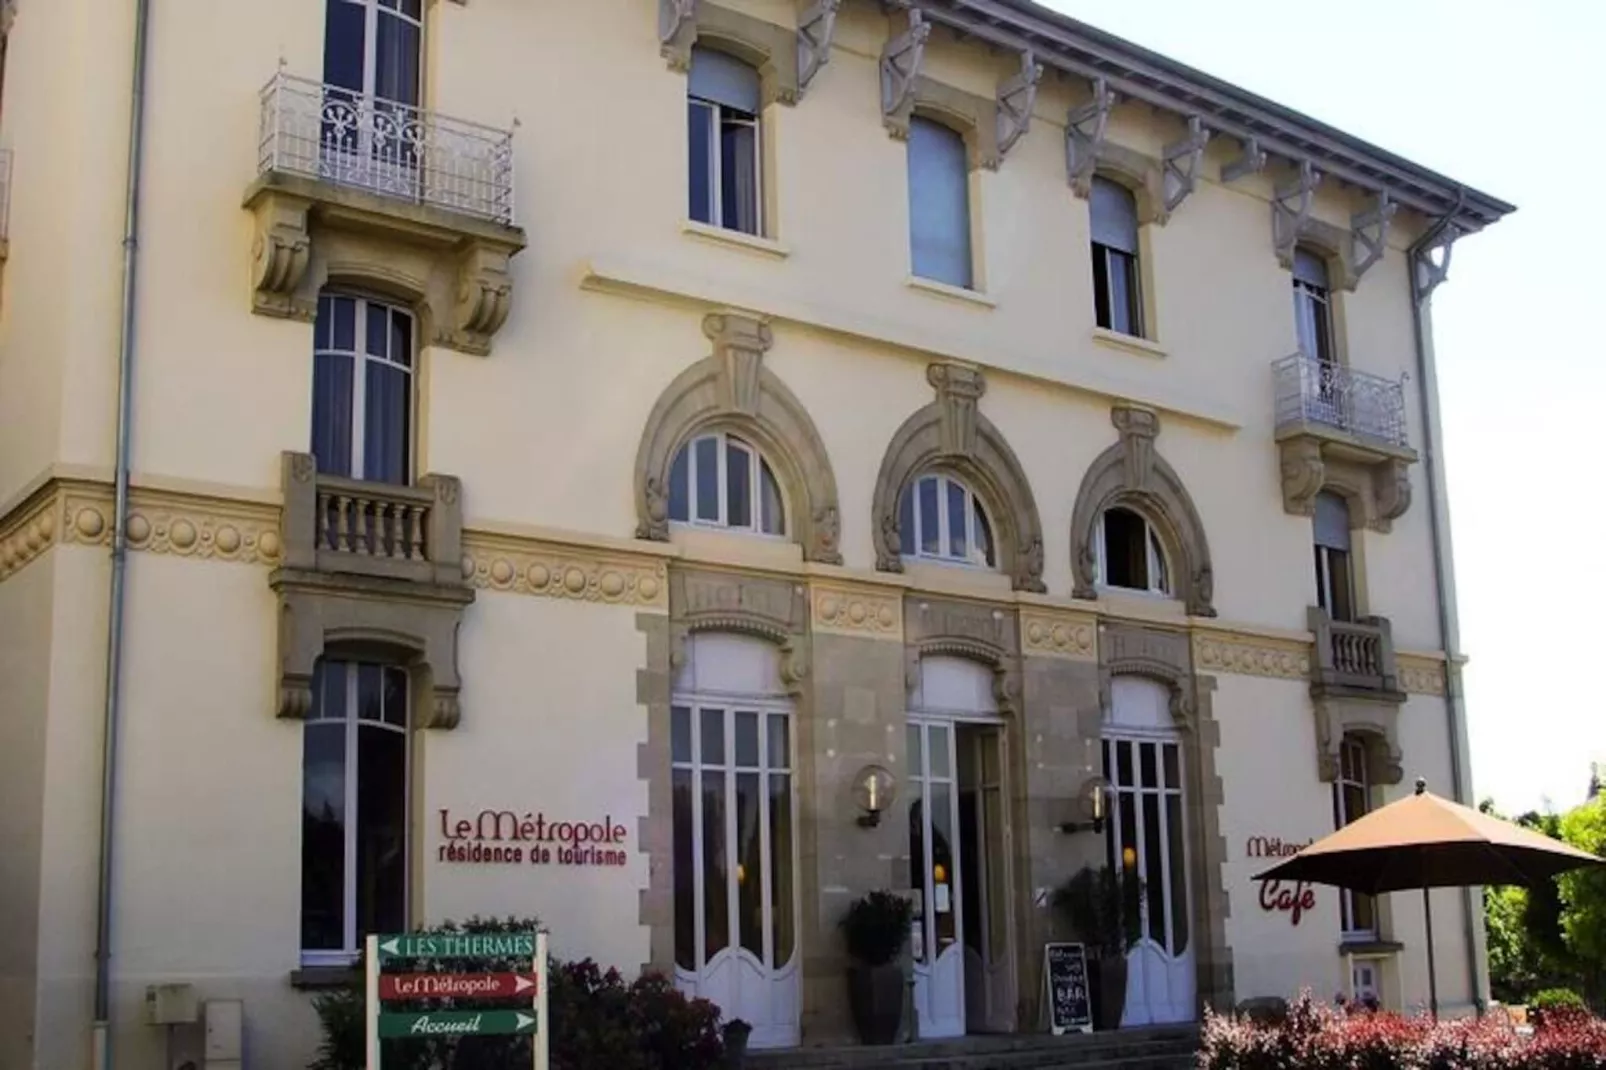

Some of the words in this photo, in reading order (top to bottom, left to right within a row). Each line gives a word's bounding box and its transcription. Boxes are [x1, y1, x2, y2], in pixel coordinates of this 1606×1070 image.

[439, 809, 472, 841] Le
[473, 809, 627, 847] Métropole
[439, 842, 522, 863] résidence
[530, 845, 549, 864] de
[558, 846, 627, 866] tourisme
[1259, 879, 1315, 926] Café
[407, 938, 437, 955] LES
[444, 936, 533, 955] THERMES
[394, 977, 413, 993] Le
[414, 975, 500, 994] Métropole
[411, 1014, 482, 1034] Accueil
